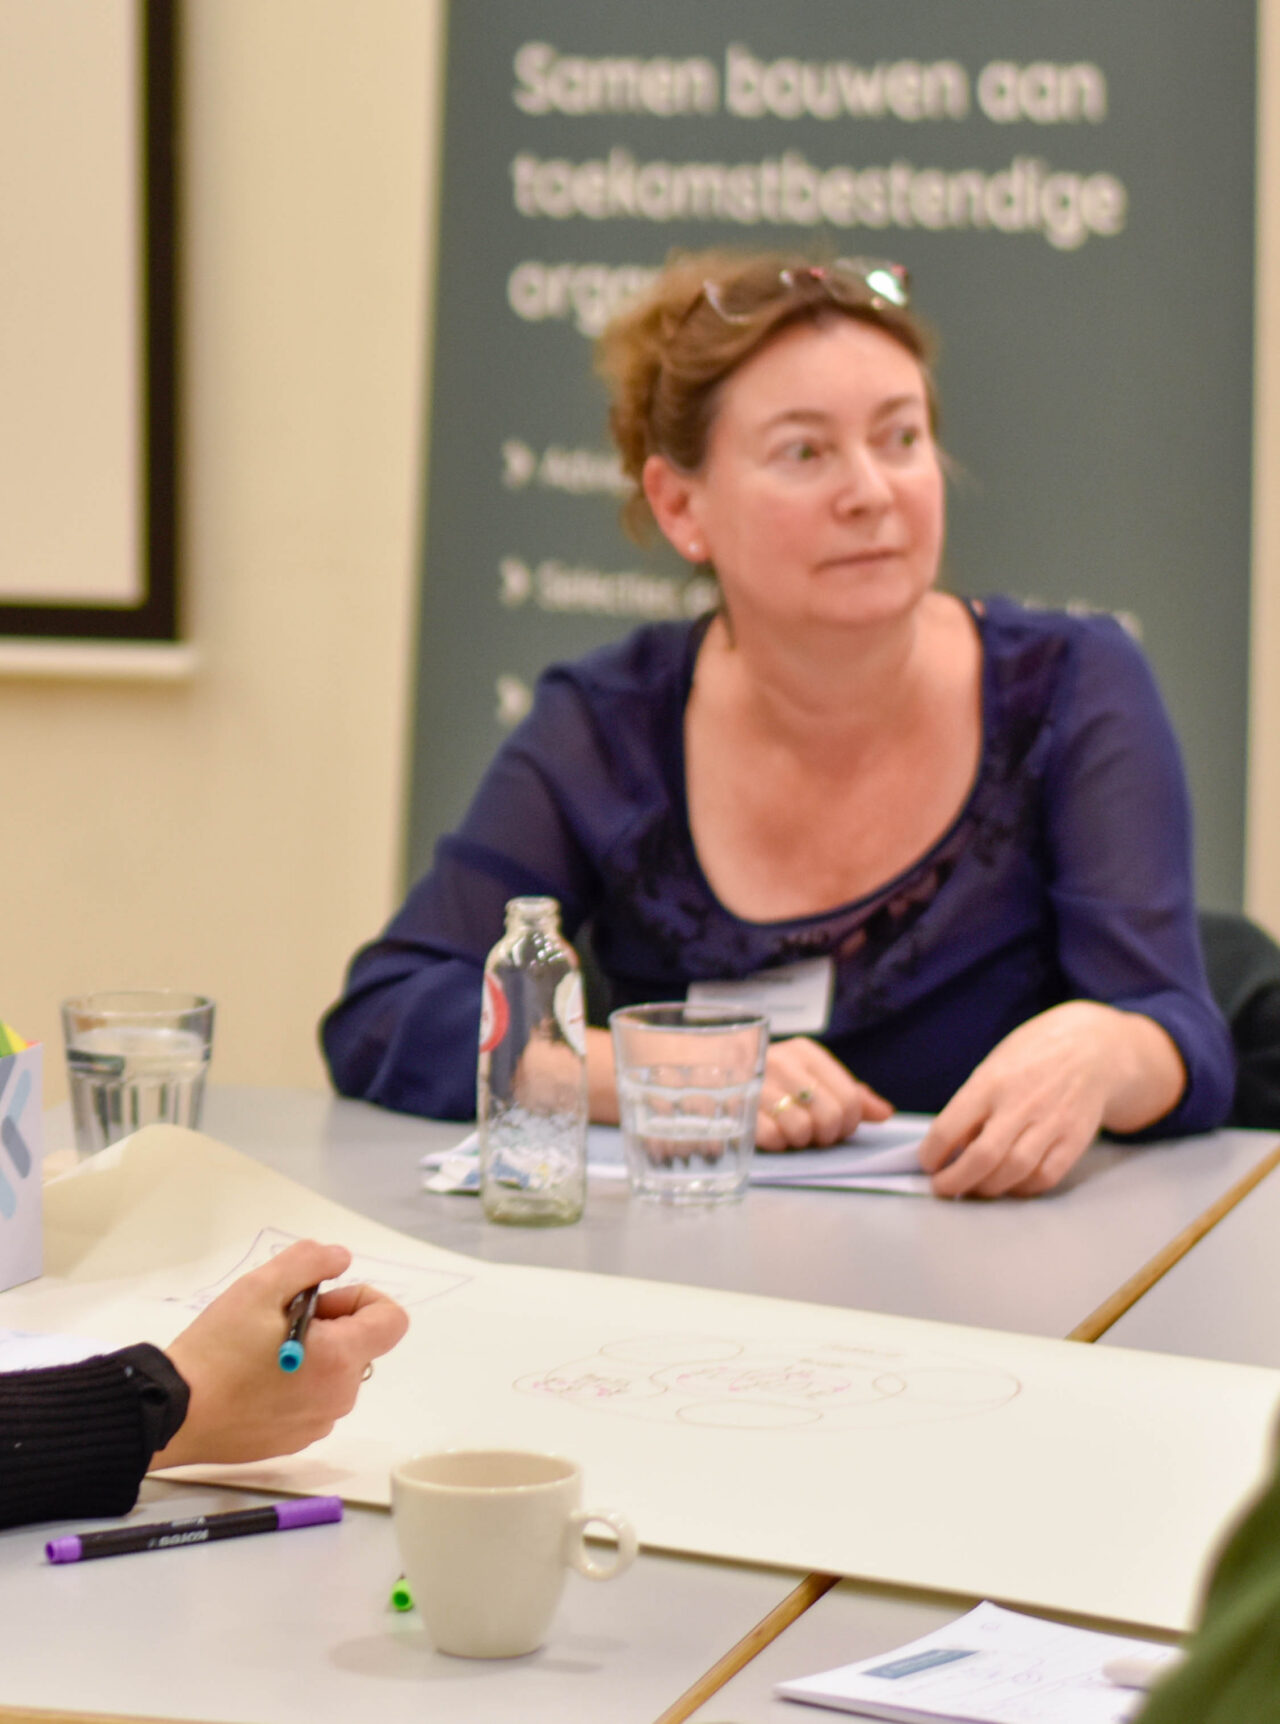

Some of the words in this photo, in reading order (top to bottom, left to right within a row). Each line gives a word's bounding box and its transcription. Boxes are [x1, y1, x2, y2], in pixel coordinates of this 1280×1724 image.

[514, 42, 719, 116] Samen
[725, 43, 970, 121] bouwen
[977, 60, 1106, 124] aan
[513, 146, 1125, 250] toekomstbestendige
[507, 262, 664, 338] orga
